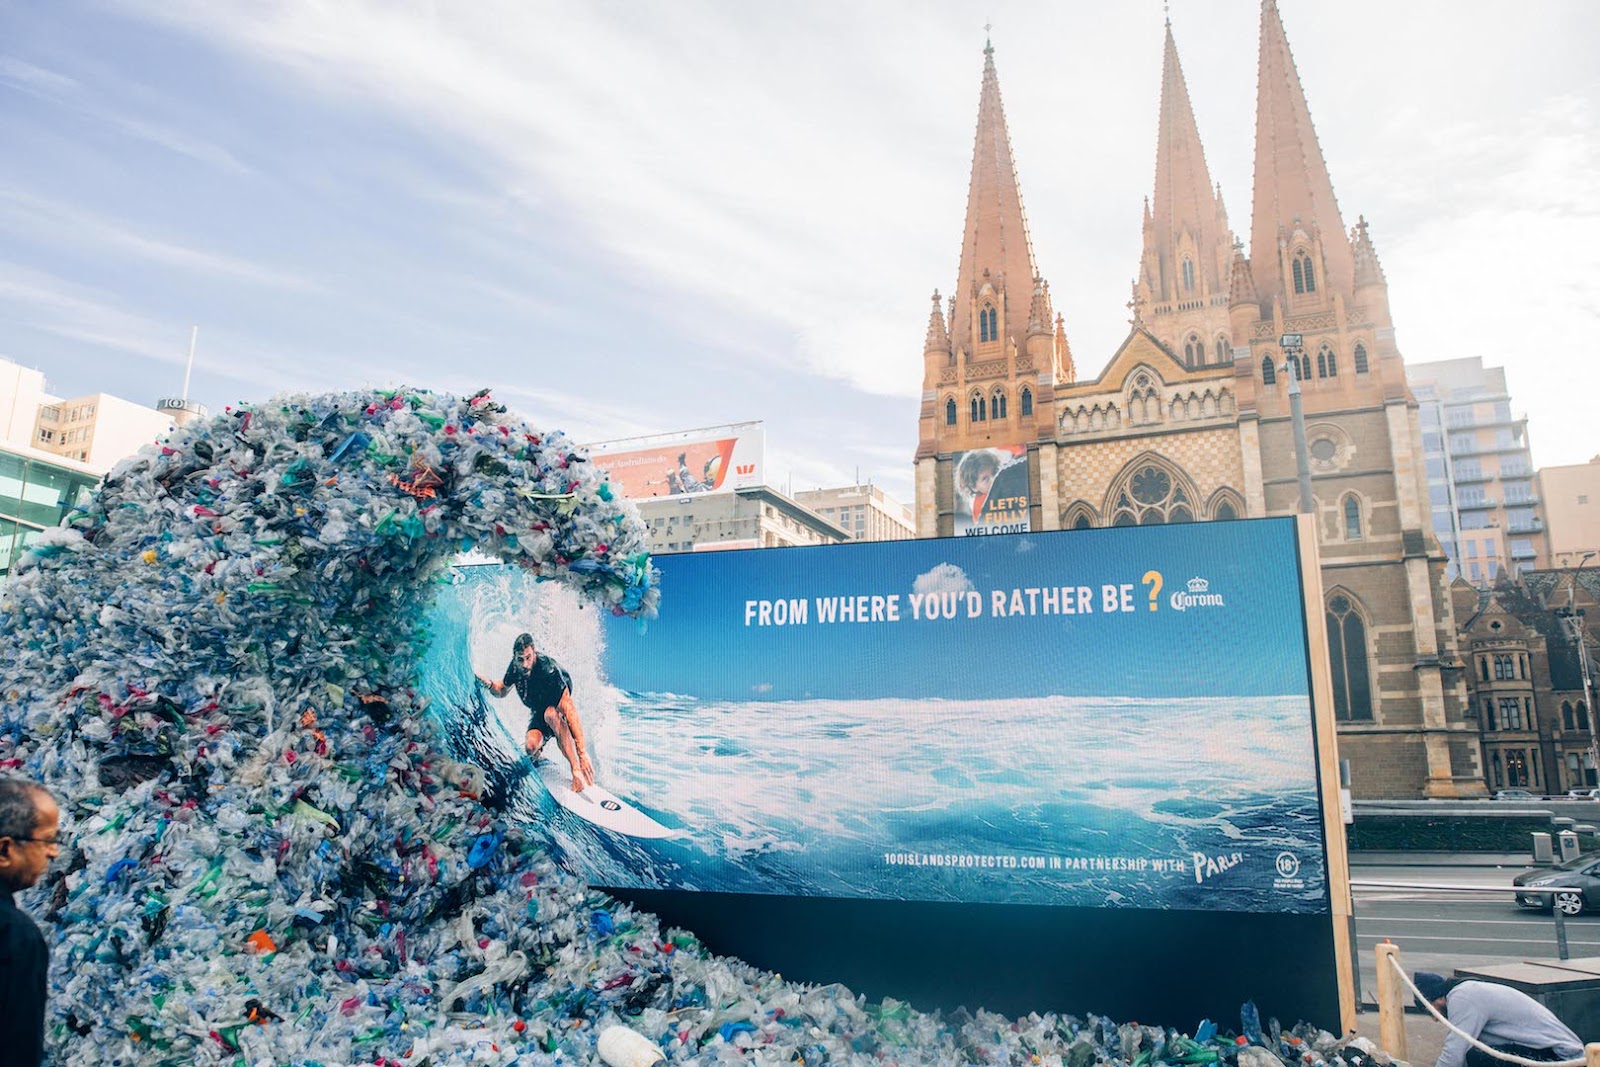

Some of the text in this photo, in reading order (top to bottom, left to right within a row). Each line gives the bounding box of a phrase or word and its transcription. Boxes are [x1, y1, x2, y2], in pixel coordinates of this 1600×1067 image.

[989, 496, 1027, 511] LET'S
[984, 509, 1028, 524] FULLY
[965, 523, 1028, 536] WELCOME
[744, 570, 1163, 626] FROM WHERE YOU'D RATHER BE ?
[1170, 590, 1223, 611] Corona
[884, 853, 1184, 872] 100ISLANDSPROTECTED.COM IN PARTNERSHIP WITH
